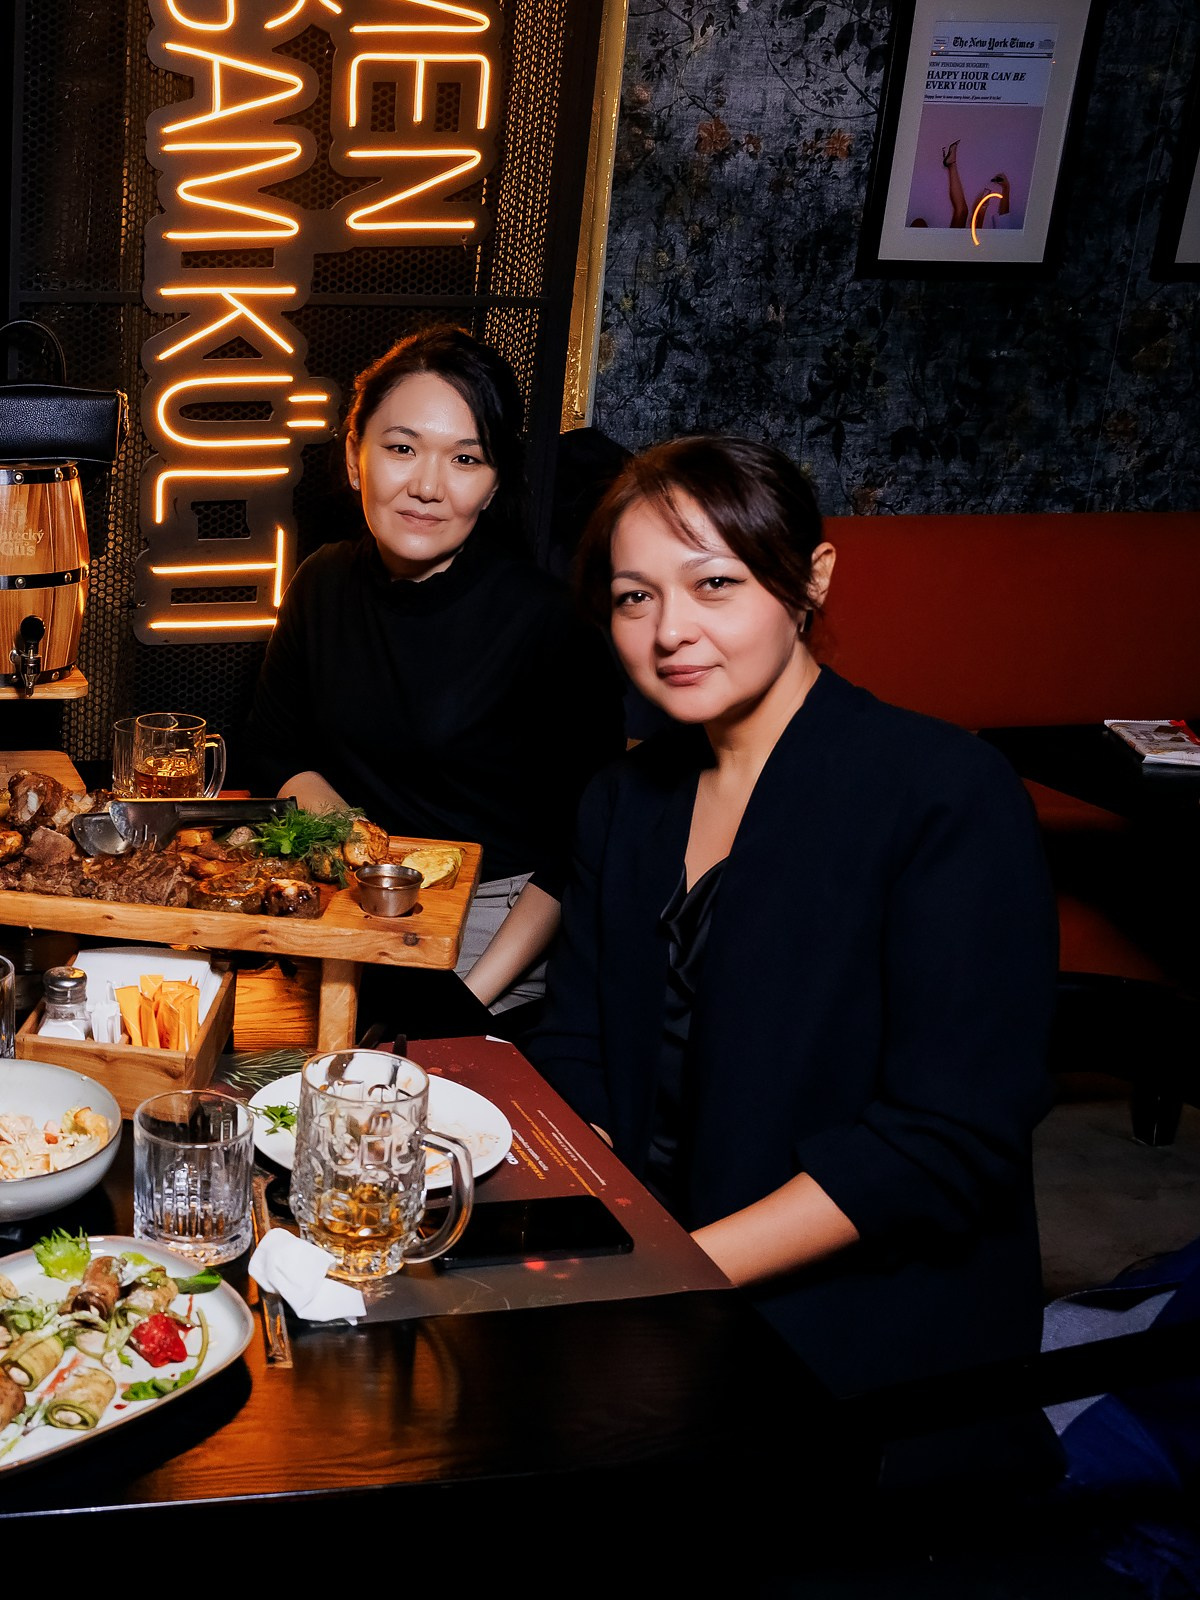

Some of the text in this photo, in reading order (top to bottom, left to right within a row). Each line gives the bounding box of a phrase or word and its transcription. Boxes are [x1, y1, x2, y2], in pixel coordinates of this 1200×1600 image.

[953, 36, 968, 48] The
[969, 37, 987, 48] New
[988, 37, 1009, 50] York
[1010, 37, 1035, 49] Times
[927, 70, 1027, 81] HAPPY HOUR CAN BE
[925, 81, 987, 91] EVERY HOUR
